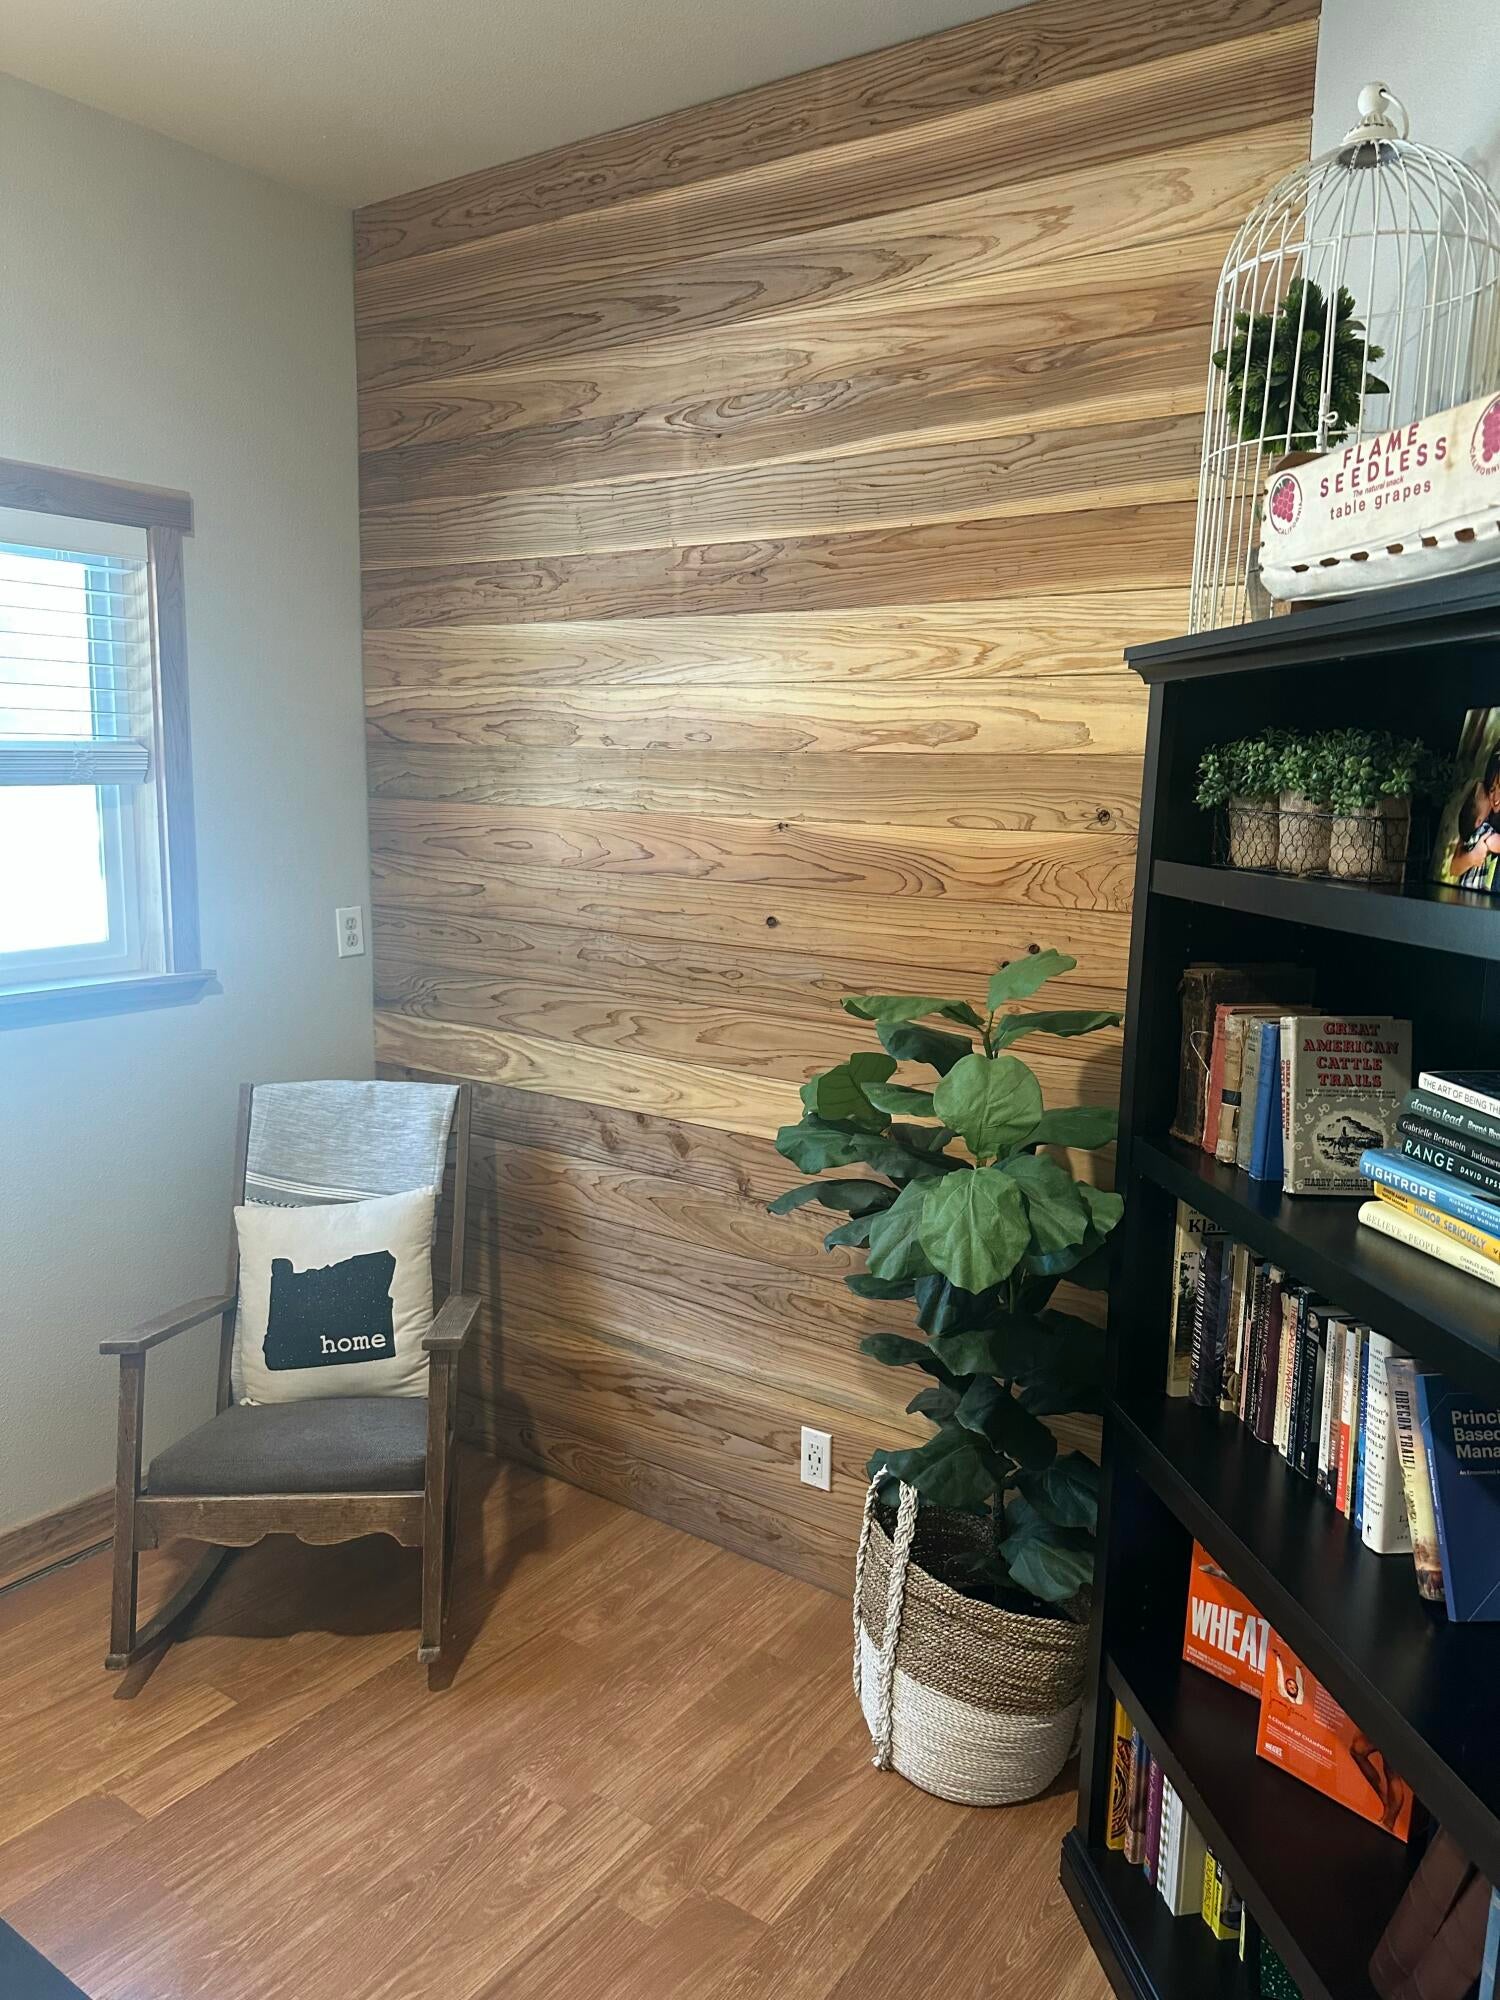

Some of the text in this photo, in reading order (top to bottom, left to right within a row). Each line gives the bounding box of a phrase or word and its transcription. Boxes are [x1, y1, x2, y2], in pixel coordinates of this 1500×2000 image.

[1342, 422, 1420, 469] FLAME
[1319, 437, 1447, 498] SEEDLESS
[1469, 444, 1500, 476] CALIFORNI
[1330, 480, 1432, 521] table grapes
[1353, 476, 1404, 498] The natural snack
[1322, 1022, 1381, 1036] GREAT
[1303, 1038, 1400, 1055] AMERICAN
[1316, 1056, 1383, 1071] CATTLE
[1318, 1073, 1382, 1088] TRAILS
[1423, 1078, 1436, 1090] THE
[1437, 1084, 1452, 1096] ART
[1452, 1089, 1463, 1099] OF
[1464, 1094, 1487, 1110] BEING
[1411, 1099, 1464, 1127] dare to lead
[1402, 1121, 1466, 1152] Gabrielle Bernstein
[1488, 1127, 1500, 1141] Bro
[1404, 1139, 1455, 1172] RANGE
[1471, 1150, 1500, 1169] Judgmen
[1363, 1162, 1437, 1203] TIGHTROPE
[1460, 1166, 1482, 1181] DAVID
[1366, 1213, 1402, 1238] BELIEVE
[1408, 1232, 1441, 1257] PEOPLE
[1443, 1219, 1487, 1249] SERIOUSLY
[319, 1333, 387, 1354] home
[1289, 1322, 1297, 1349] ROAD
[1284, 1365, 1293, 1409] TRAVELED
[1394, 1390, 1415, 1468] OREGON TRAIL
[1451, 1409, 1500, 1425] Princi
[1455, 1443, 1500, 1459] Mana
[1191, 1596, 1271, 1673] WHEAT
[1301, 1734, 1333, 1756] CHAMPIONS
